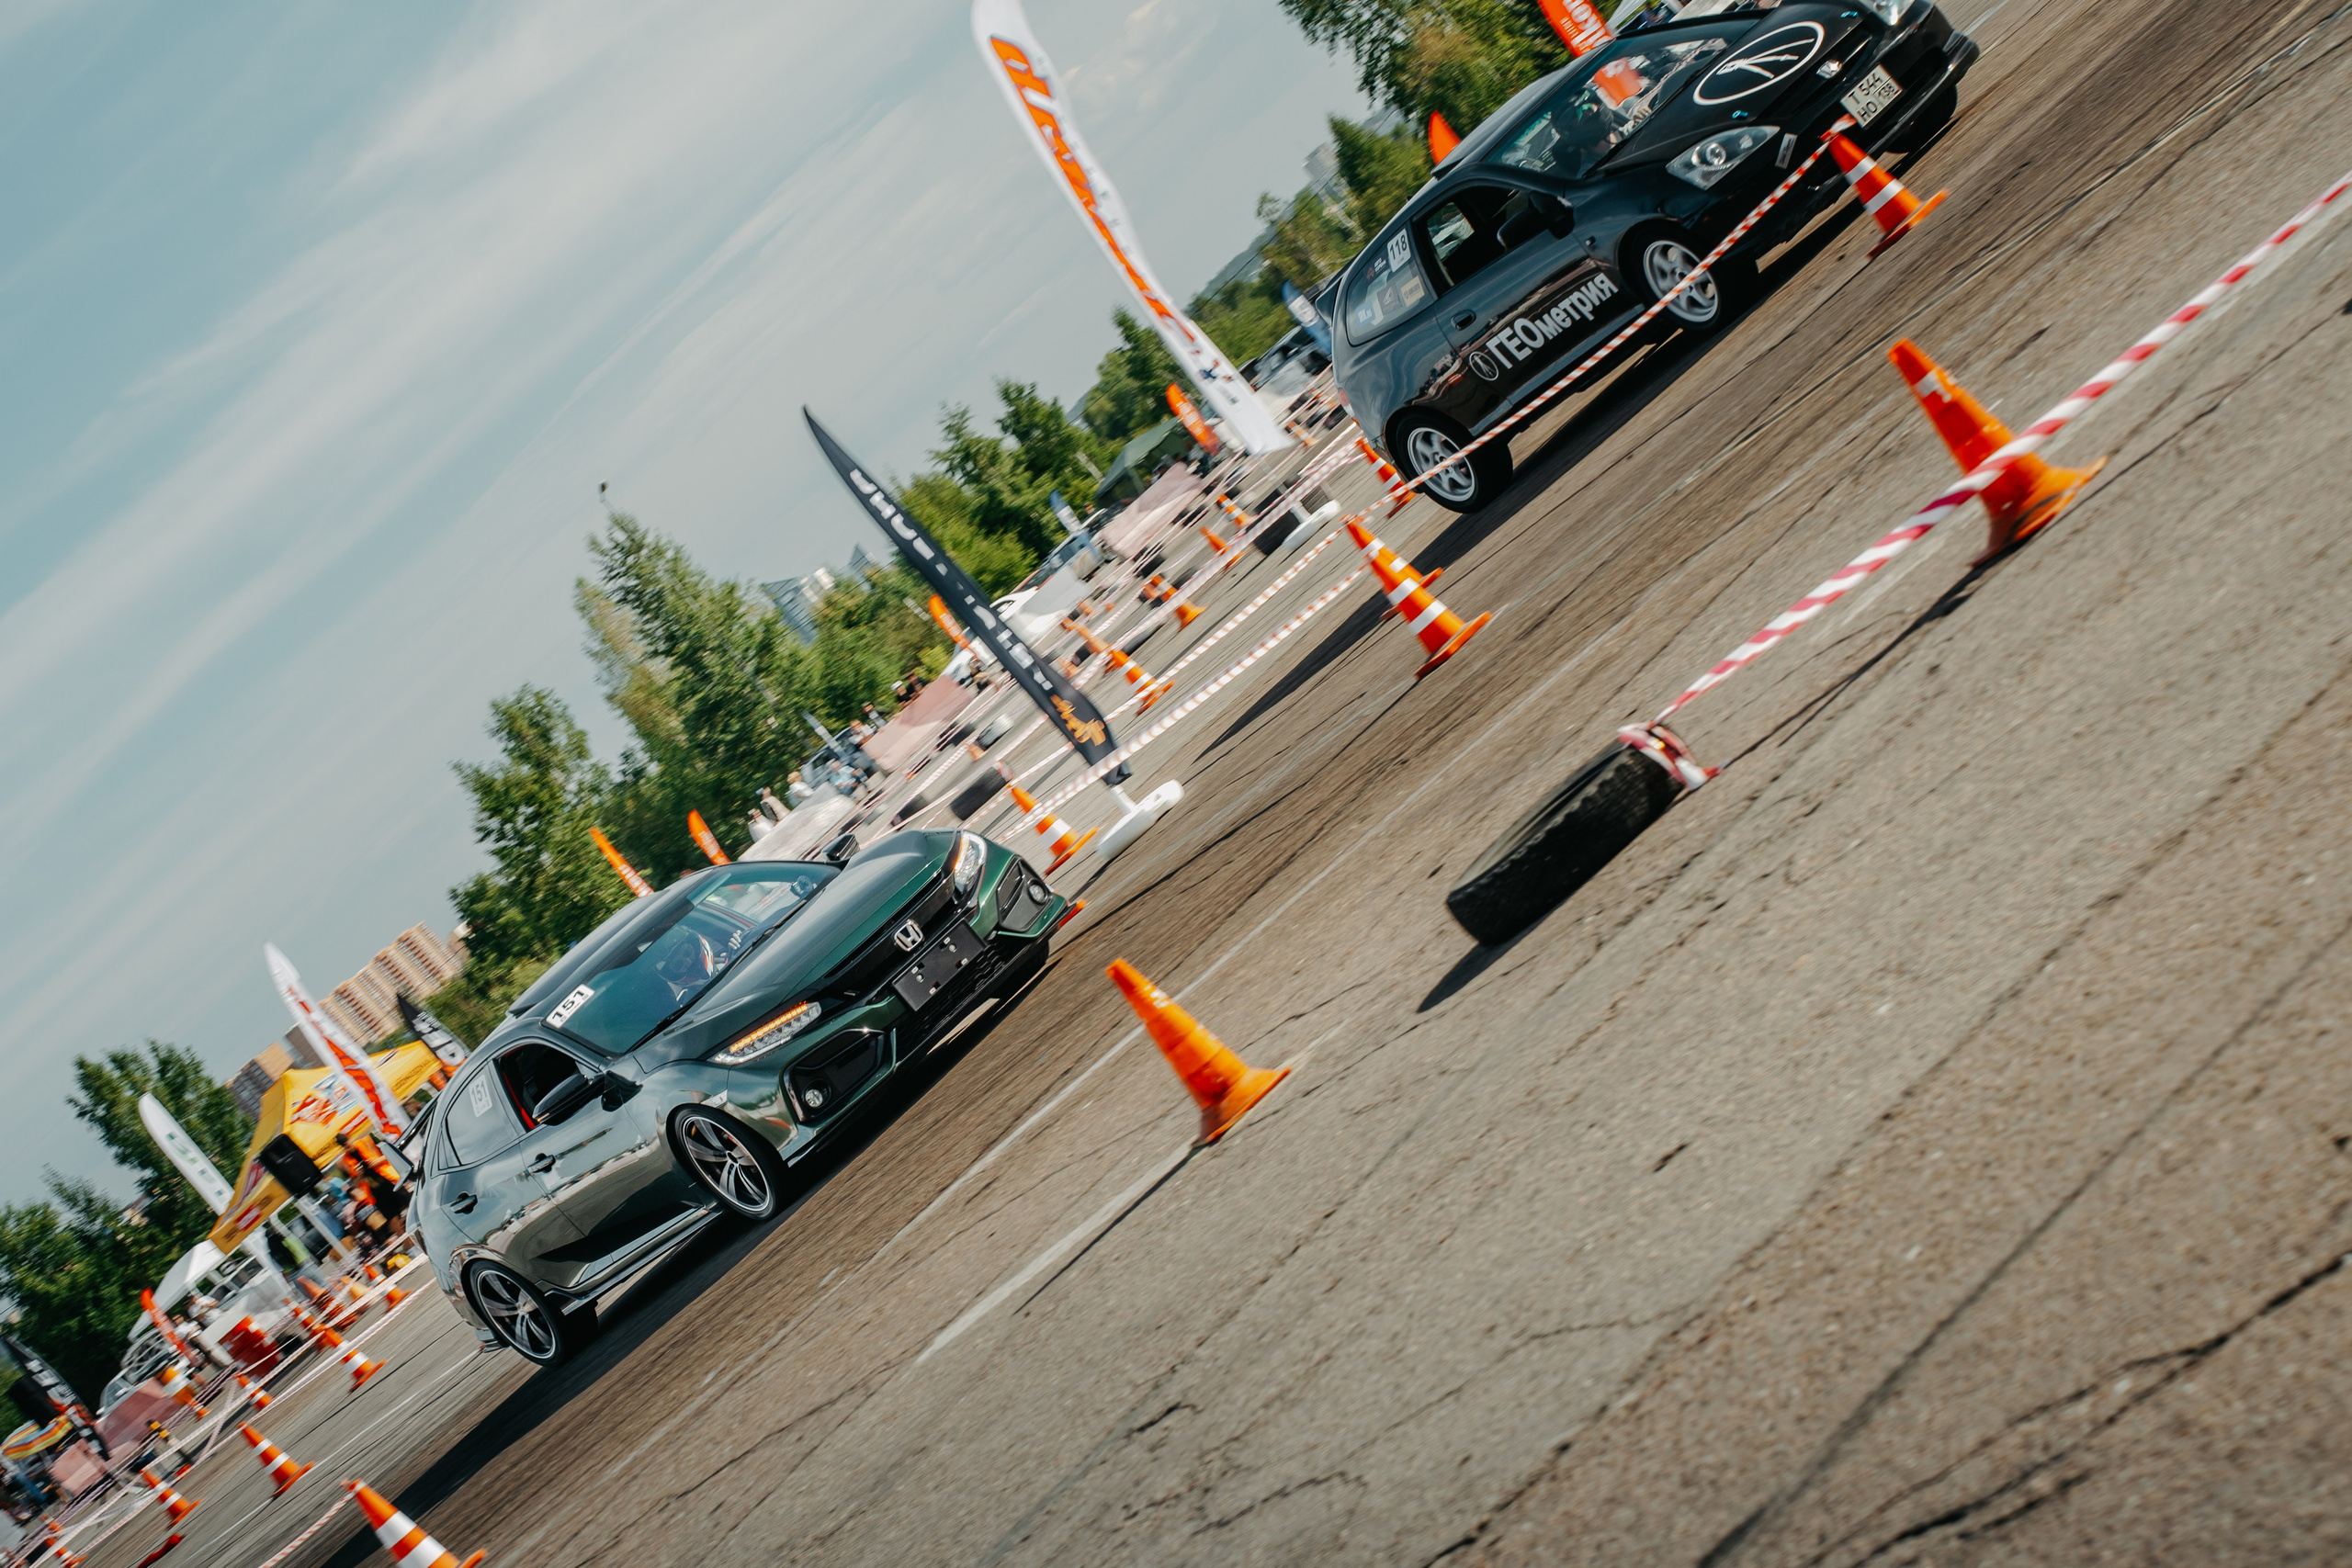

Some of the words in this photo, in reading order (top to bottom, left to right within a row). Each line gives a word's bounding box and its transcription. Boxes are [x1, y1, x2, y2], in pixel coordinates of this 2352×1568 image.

[1858, 73, 1883, 96] 544
[1389, 234, 1408, 261] 118
[1486, 272, 1620, 369] ГЕОметрия
[551, 990, 585, 1020] 151
[470, 1079, 488, 1105] 151
